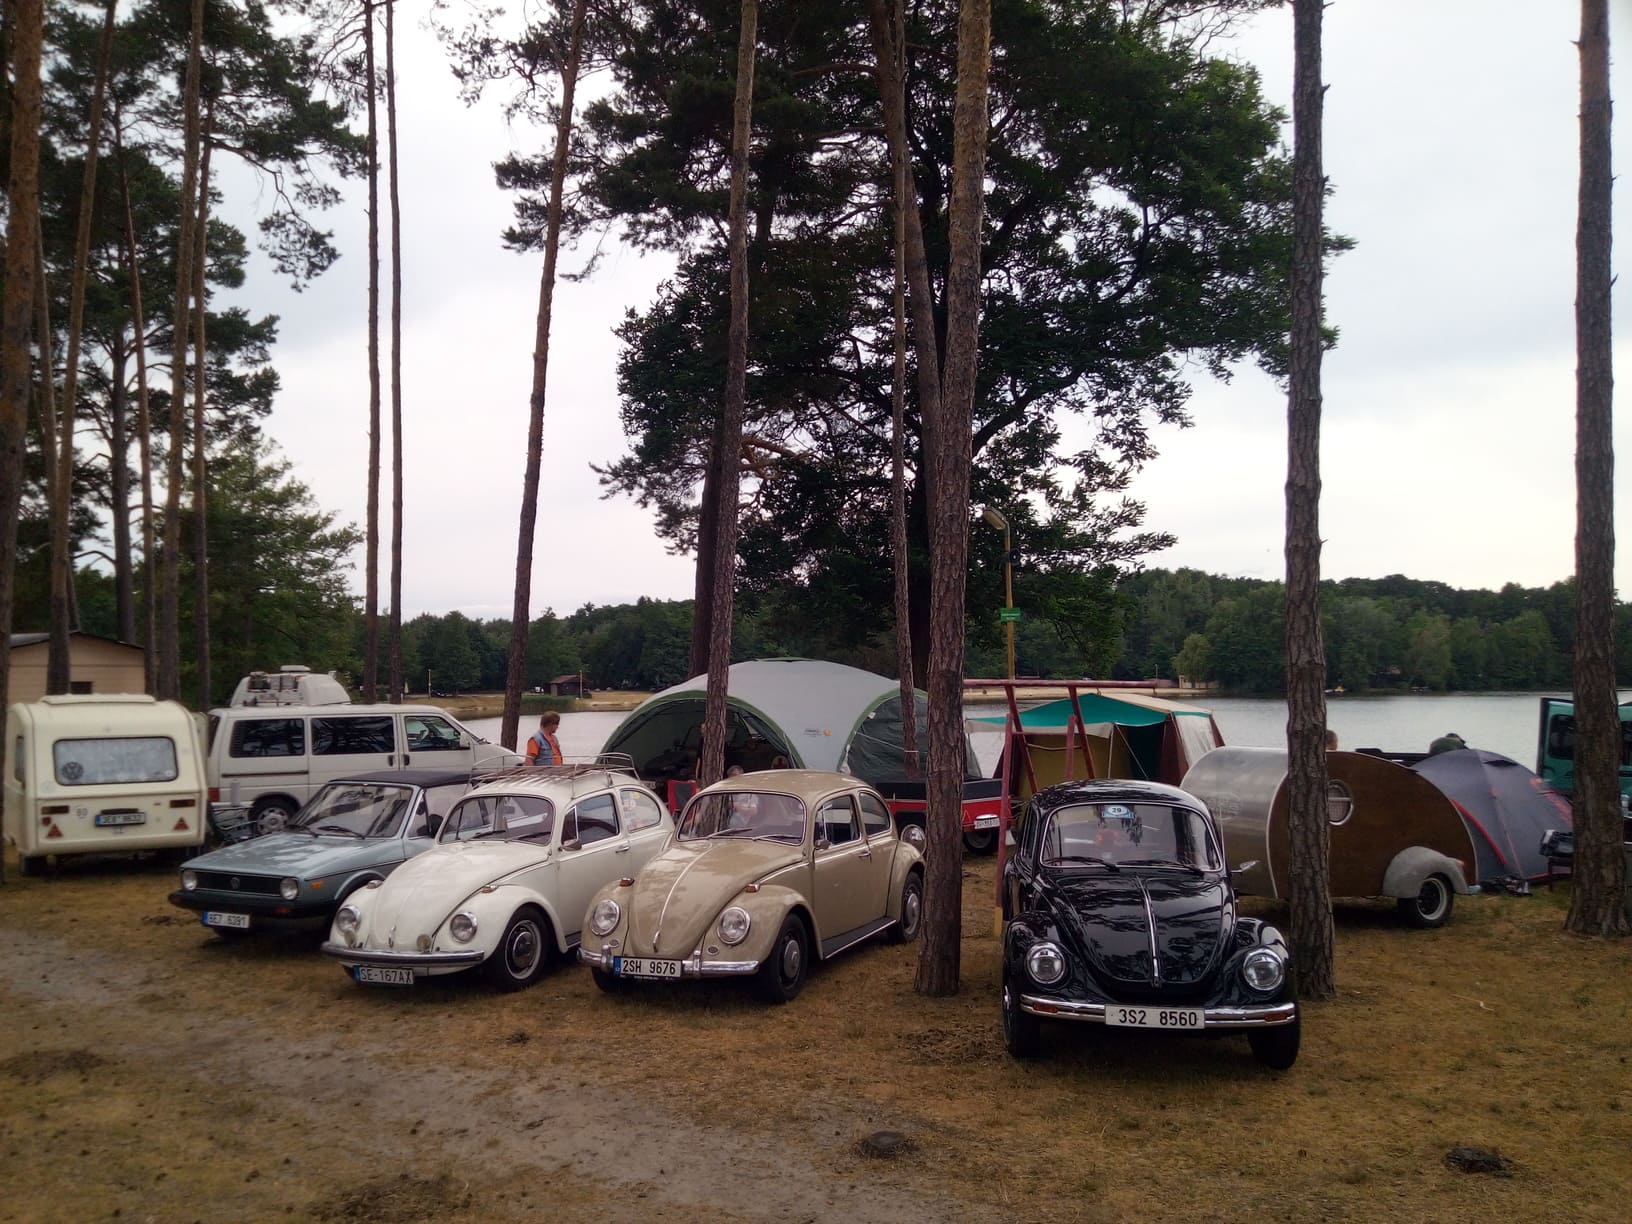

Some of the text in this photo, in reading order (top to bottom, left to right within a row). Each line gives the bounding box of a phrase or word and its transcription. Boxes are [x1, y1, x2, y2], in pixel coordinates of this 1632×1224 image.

[360, 967, 413, 984] SE-167AX
[622, 959, 642, 973] 2SH
[649, 961, 676, 975] 9676
[1118, 1008, 1198, 1026] 3S2 8560
